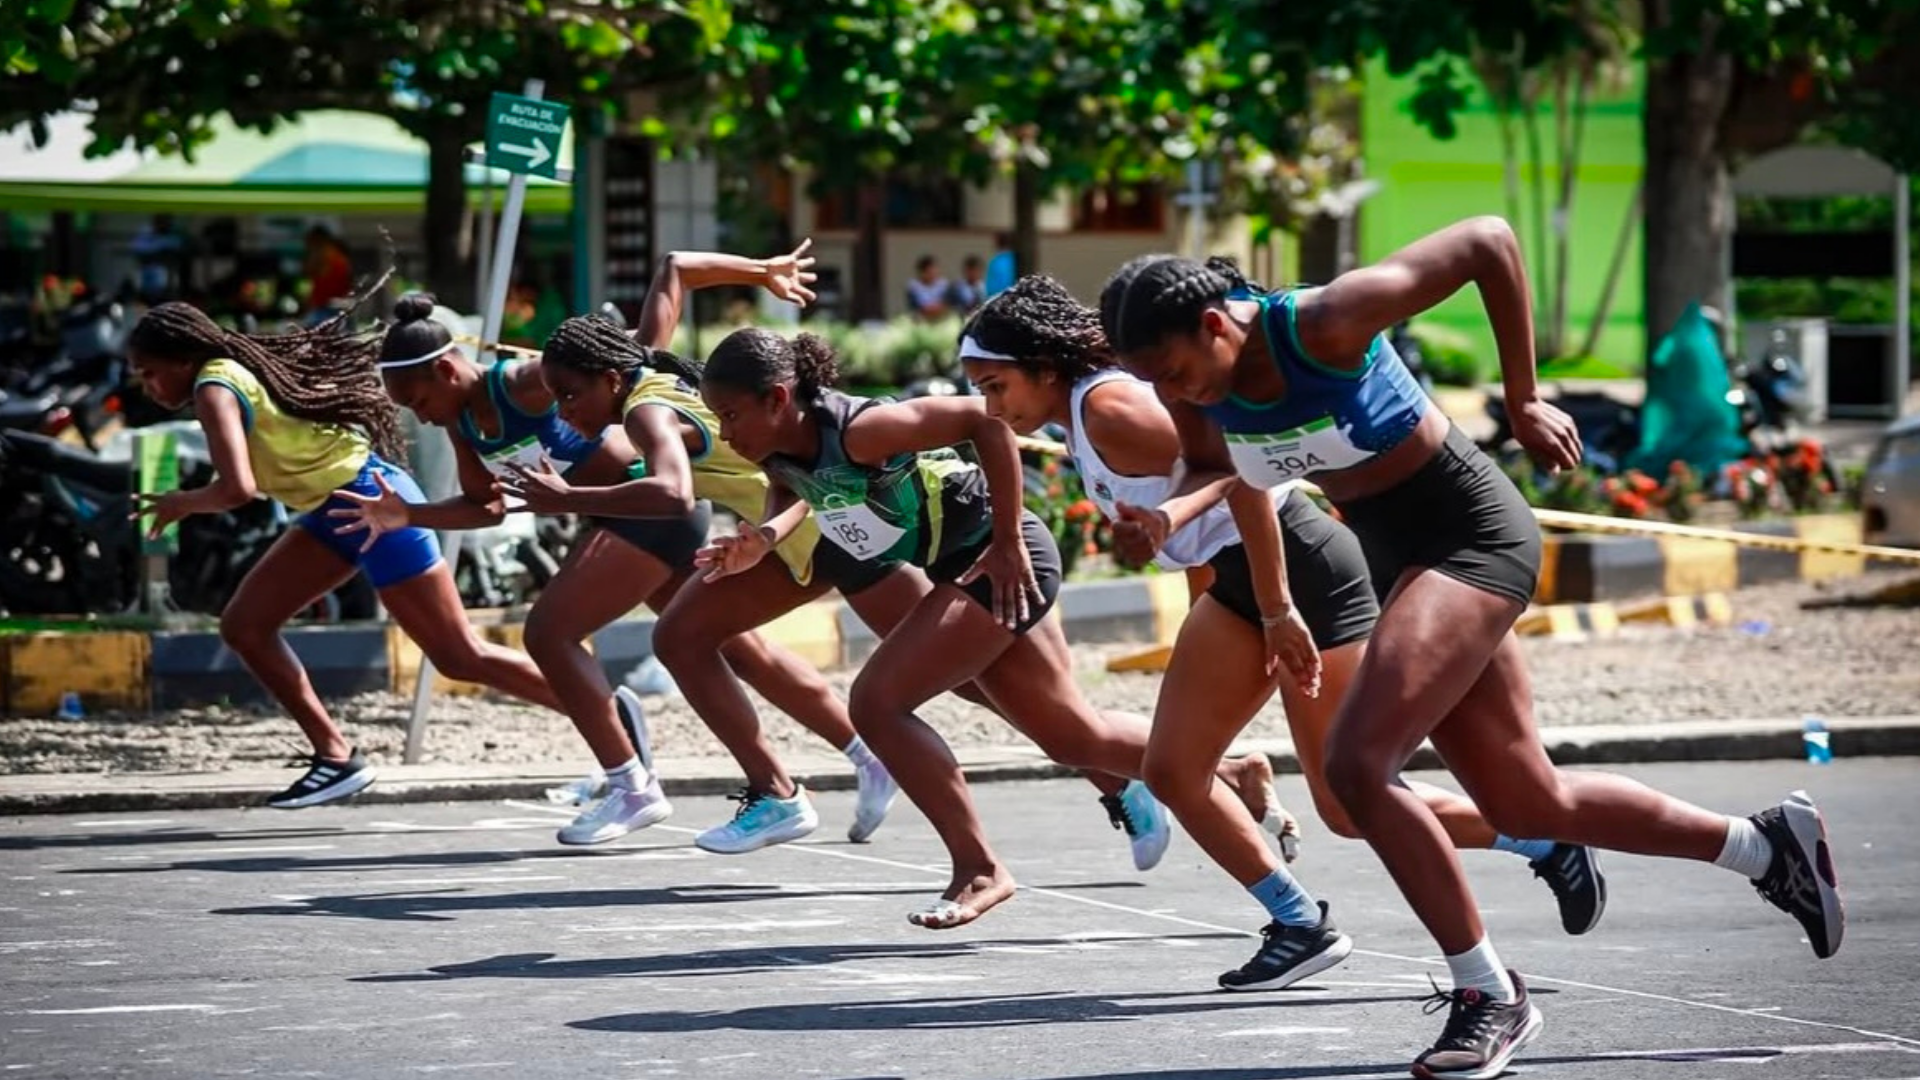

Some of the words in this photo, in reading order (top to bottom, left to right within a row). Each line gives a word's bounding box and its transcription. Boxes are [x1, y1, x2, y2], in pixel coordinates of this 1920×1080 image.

[511, 103, 538, 116] RUTA
[540, 110, 553, 120] DE
[1267, 453, 1325, 477] 394
[832, 521, 869, 544] 186
